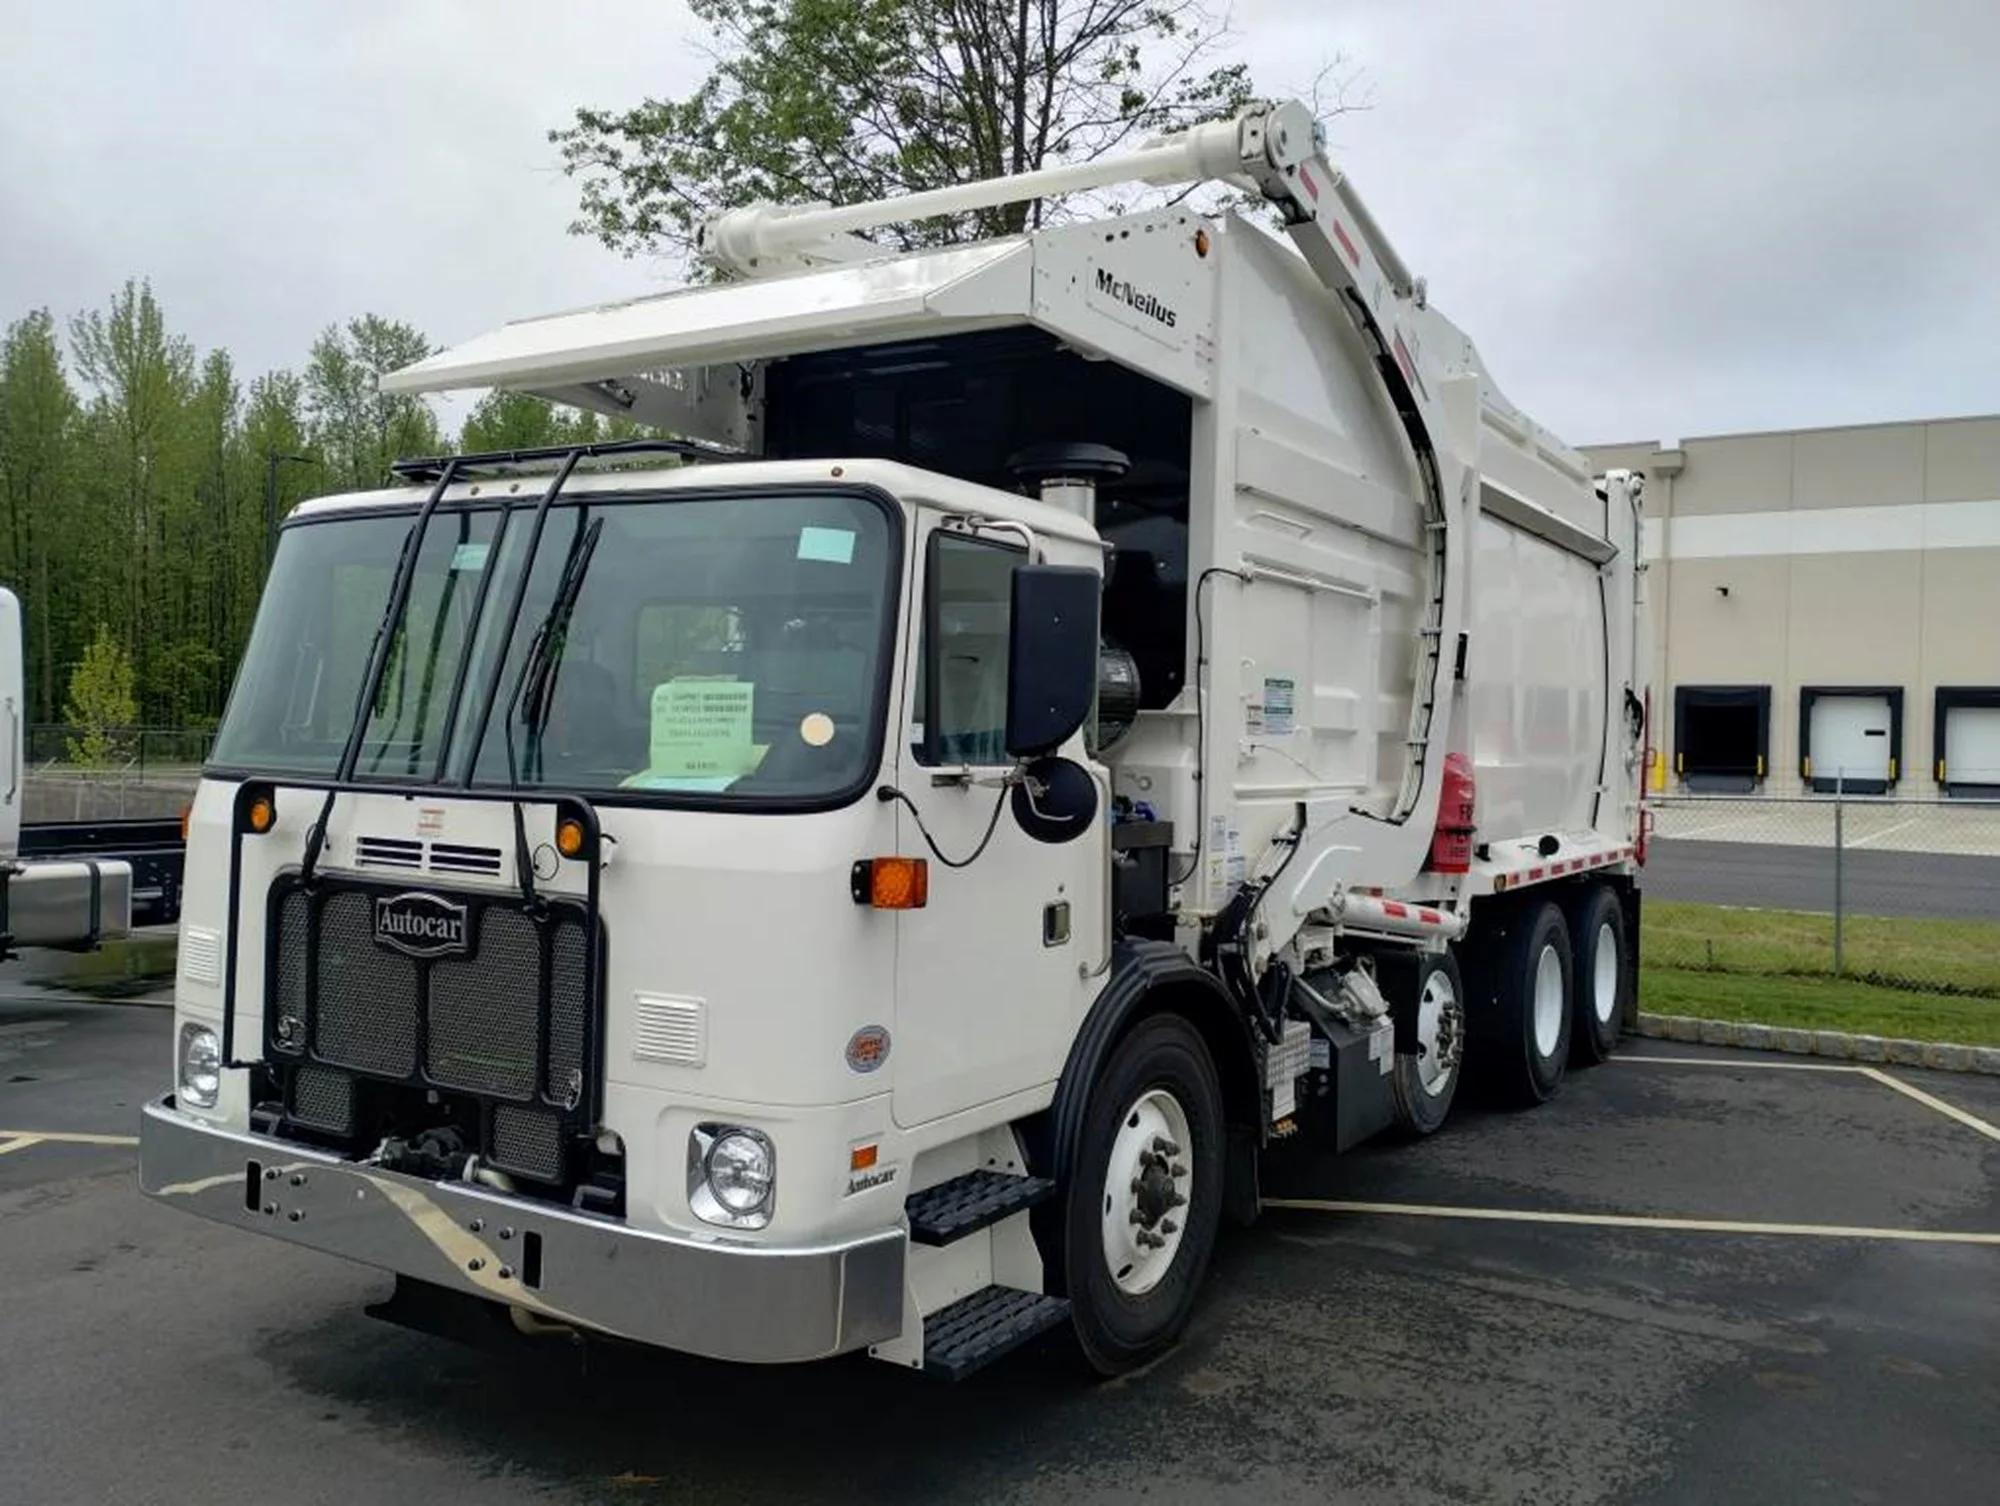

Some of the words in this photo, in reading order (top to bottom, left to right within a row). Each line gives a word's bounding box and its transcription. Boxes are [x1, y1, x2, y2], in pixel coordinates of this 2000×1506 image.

[1096, 268, 1177, 328] McNeilus
[380, 905, 461, 939] Autocar
[844, 1168, 897, 1197] Autocar
